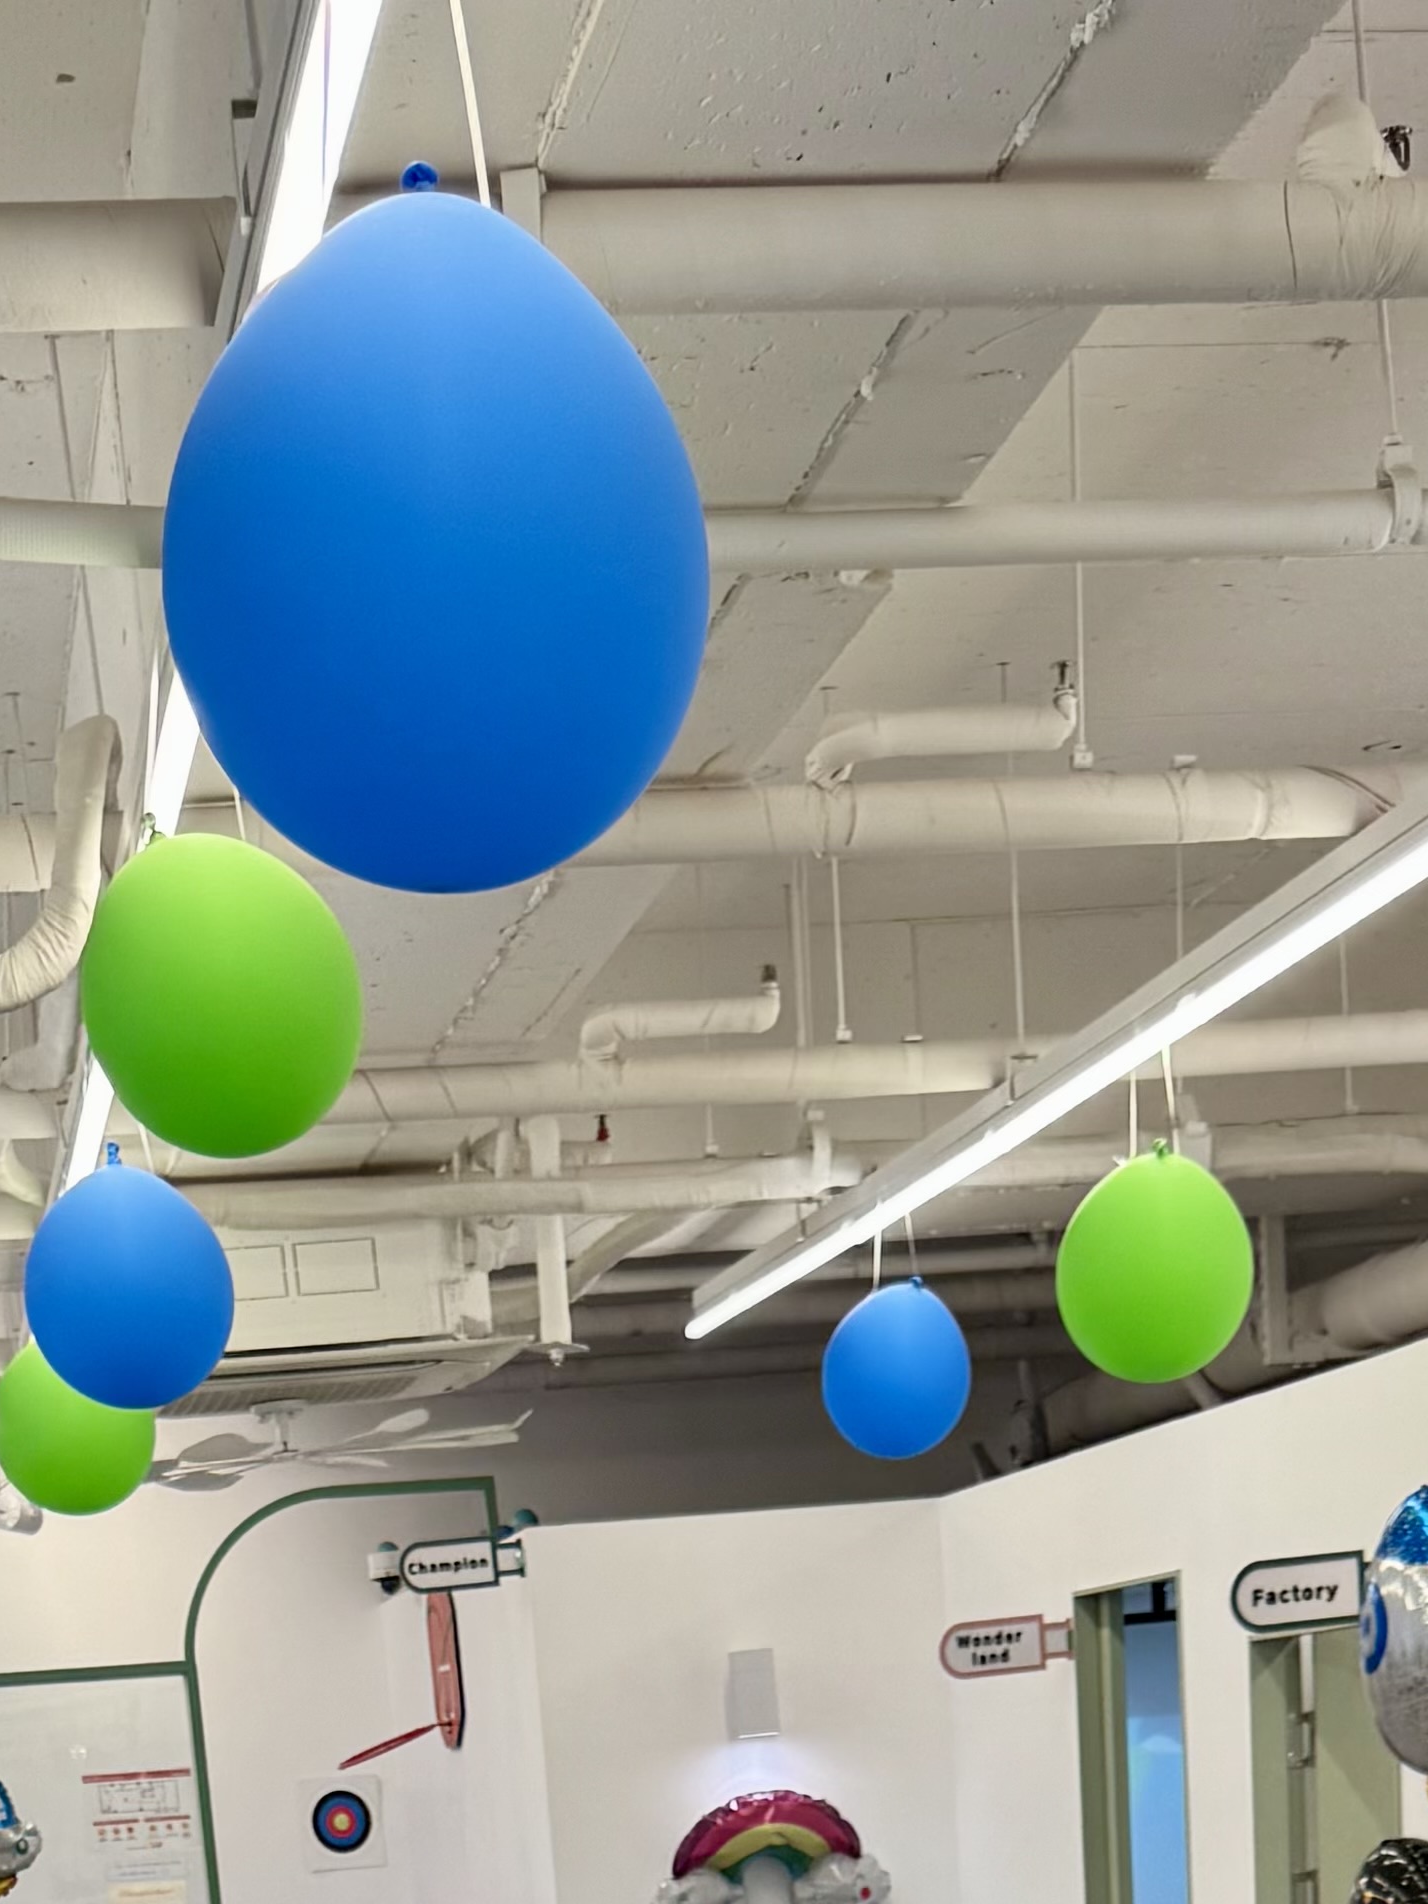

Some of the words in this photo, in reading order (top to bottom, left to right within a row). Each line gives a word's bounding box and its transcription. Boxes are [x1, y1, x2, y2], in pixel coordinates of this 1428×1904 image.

[408, 1557, 489, 1575] Champion
[1252, 1584, 1339, 1607] Factory
[956, 1630, 1022, 1648] Wonder
[972, 1649, 1010, 1667] land
